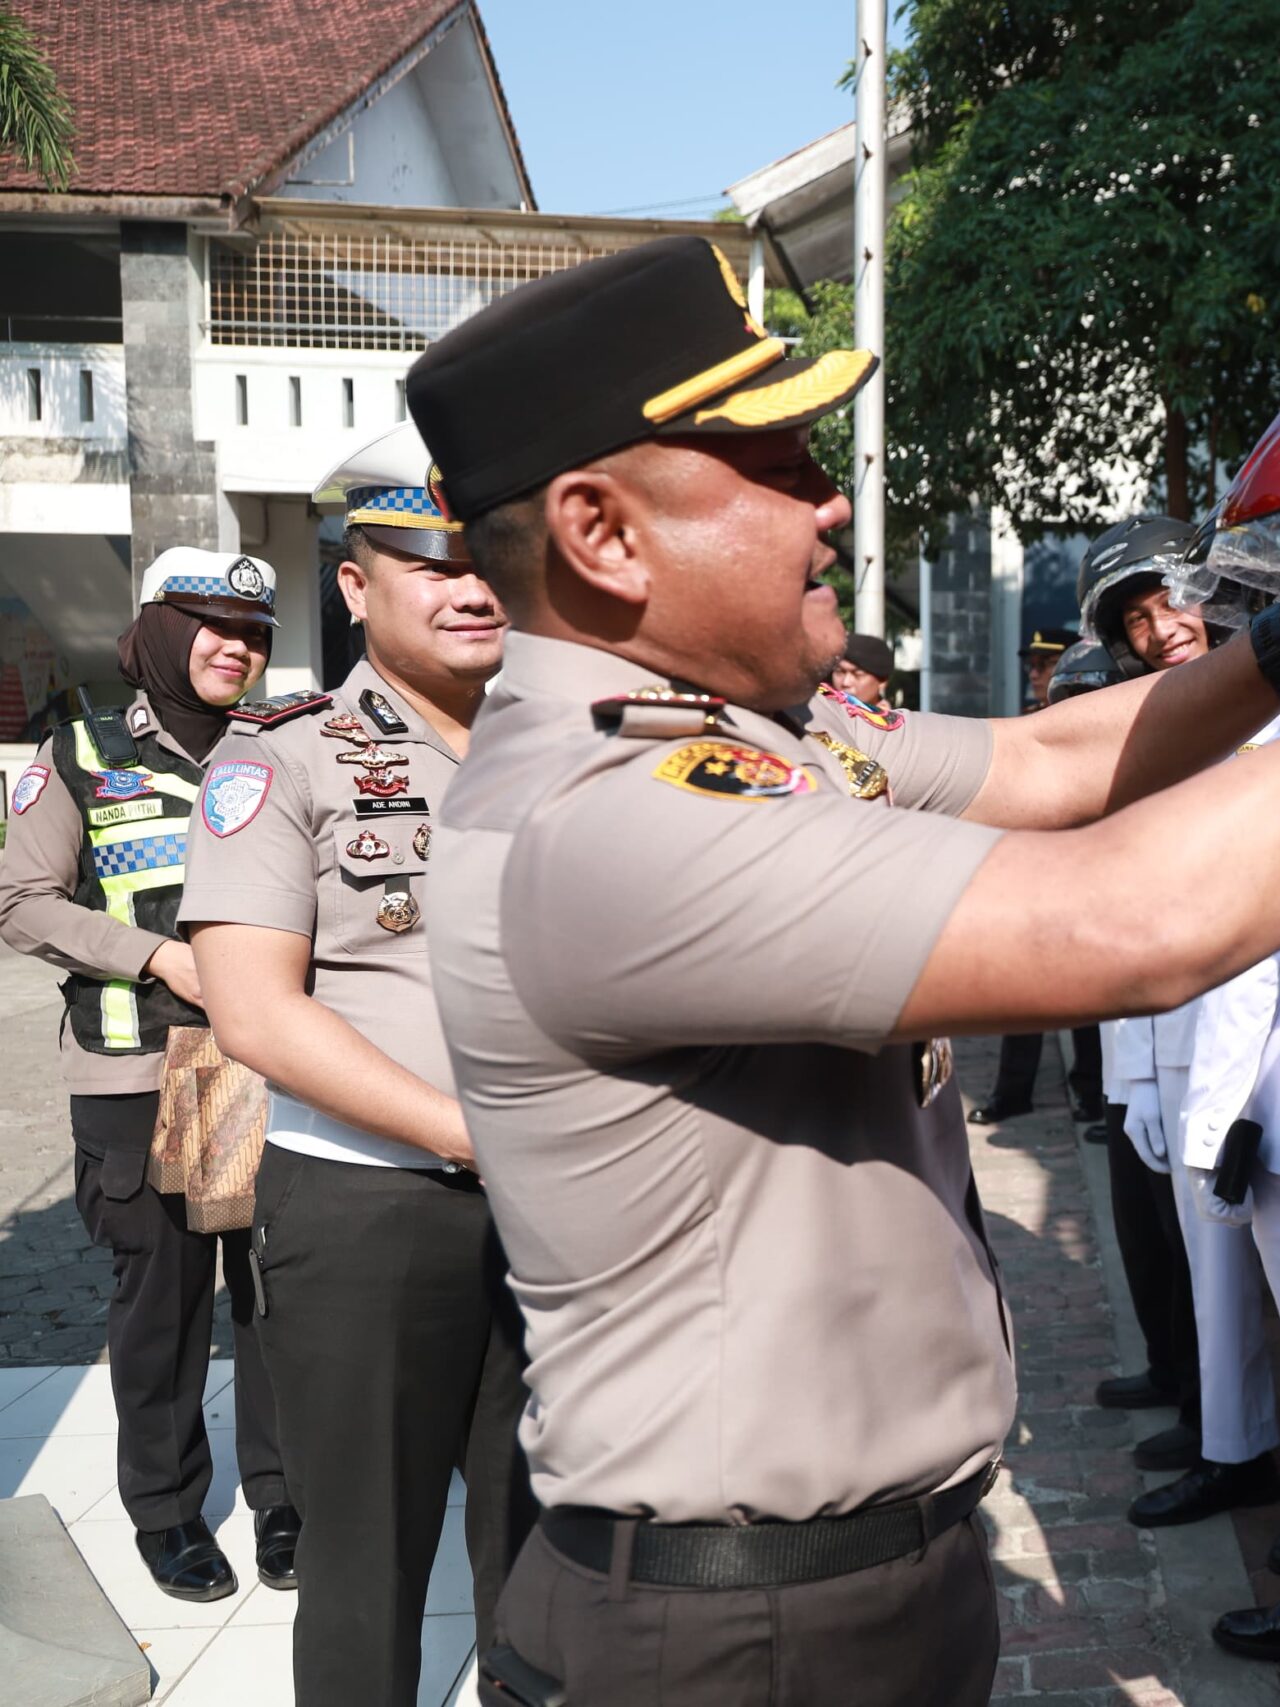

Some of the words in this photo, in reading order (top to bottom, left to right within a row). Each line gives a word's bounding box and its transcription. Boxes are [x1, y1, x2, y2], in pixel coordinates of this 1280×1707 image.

[236, 764, 269, 779] LINTAS
[372, 801, 387, 809] ADE
[95, 806, 126, 823] NANDA
